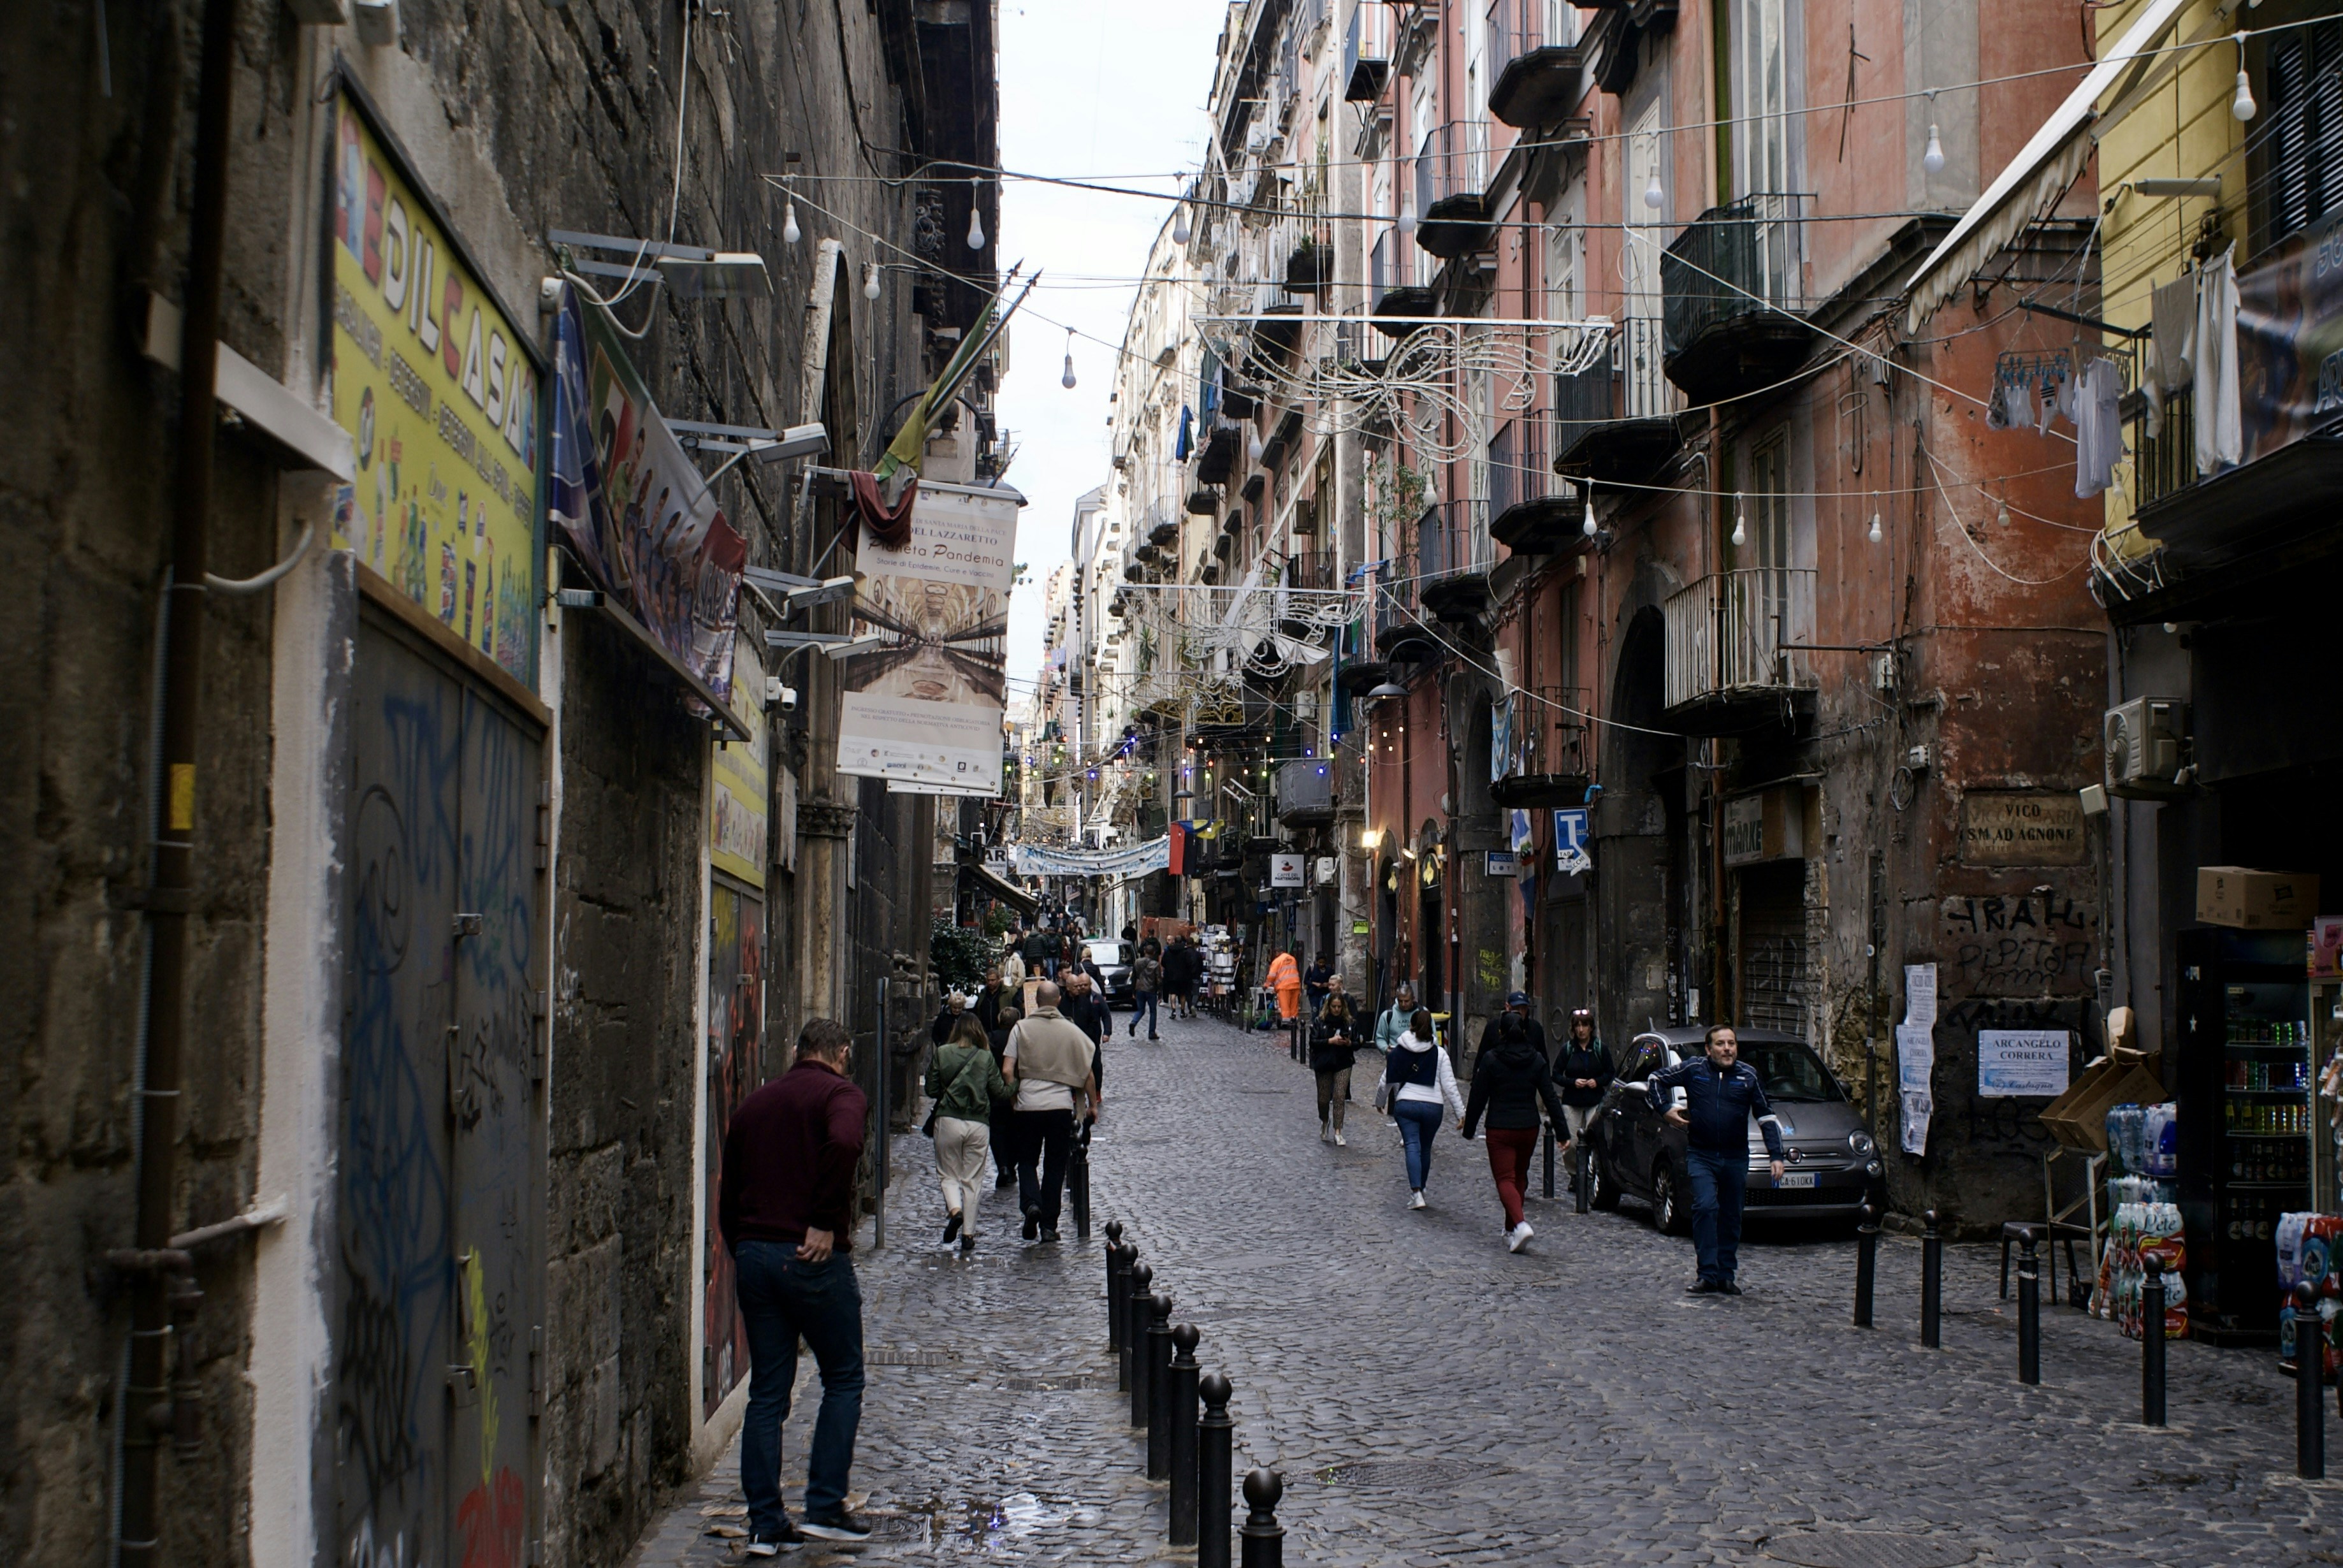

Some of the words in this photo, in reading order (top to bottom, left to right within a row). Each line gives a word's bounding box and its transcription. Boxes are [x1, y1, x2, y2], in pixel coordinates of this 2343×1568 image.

[924, 519, 946, 528] SANTA
[947, 521, 968, 530] MARIA
[969, 525, 989, 533] DELLA
[990, 527, 1006, 536] PACE
[930, 529, 997, 546] LAZZARETTO
[932, 544, 1004, 567] Pandemia
[876, 557, 897, 566] Storie
[943, 566, 961, 574] Cure
[969, 569, 994, 579] Vaccini
[851, 706, 878, 714] INGRESSO
[910, 713, 951, 722] PRENOTAZIONE
[952, 716, 990, 726] OBBLIGATORIA
[917, 719, 948, 729] NORMATIVA
[950, 723, 980, 731] ANTICOVID
[2006, 804, 2040, 817] VICO
[1994, 829, 2013, 841] AD
[2019, 829, 2075, 841] AGNONE
[1993, 1039, 2061, 1049] ARCANGELO
[2000, 1051, 2054, 1061] CORRERA
